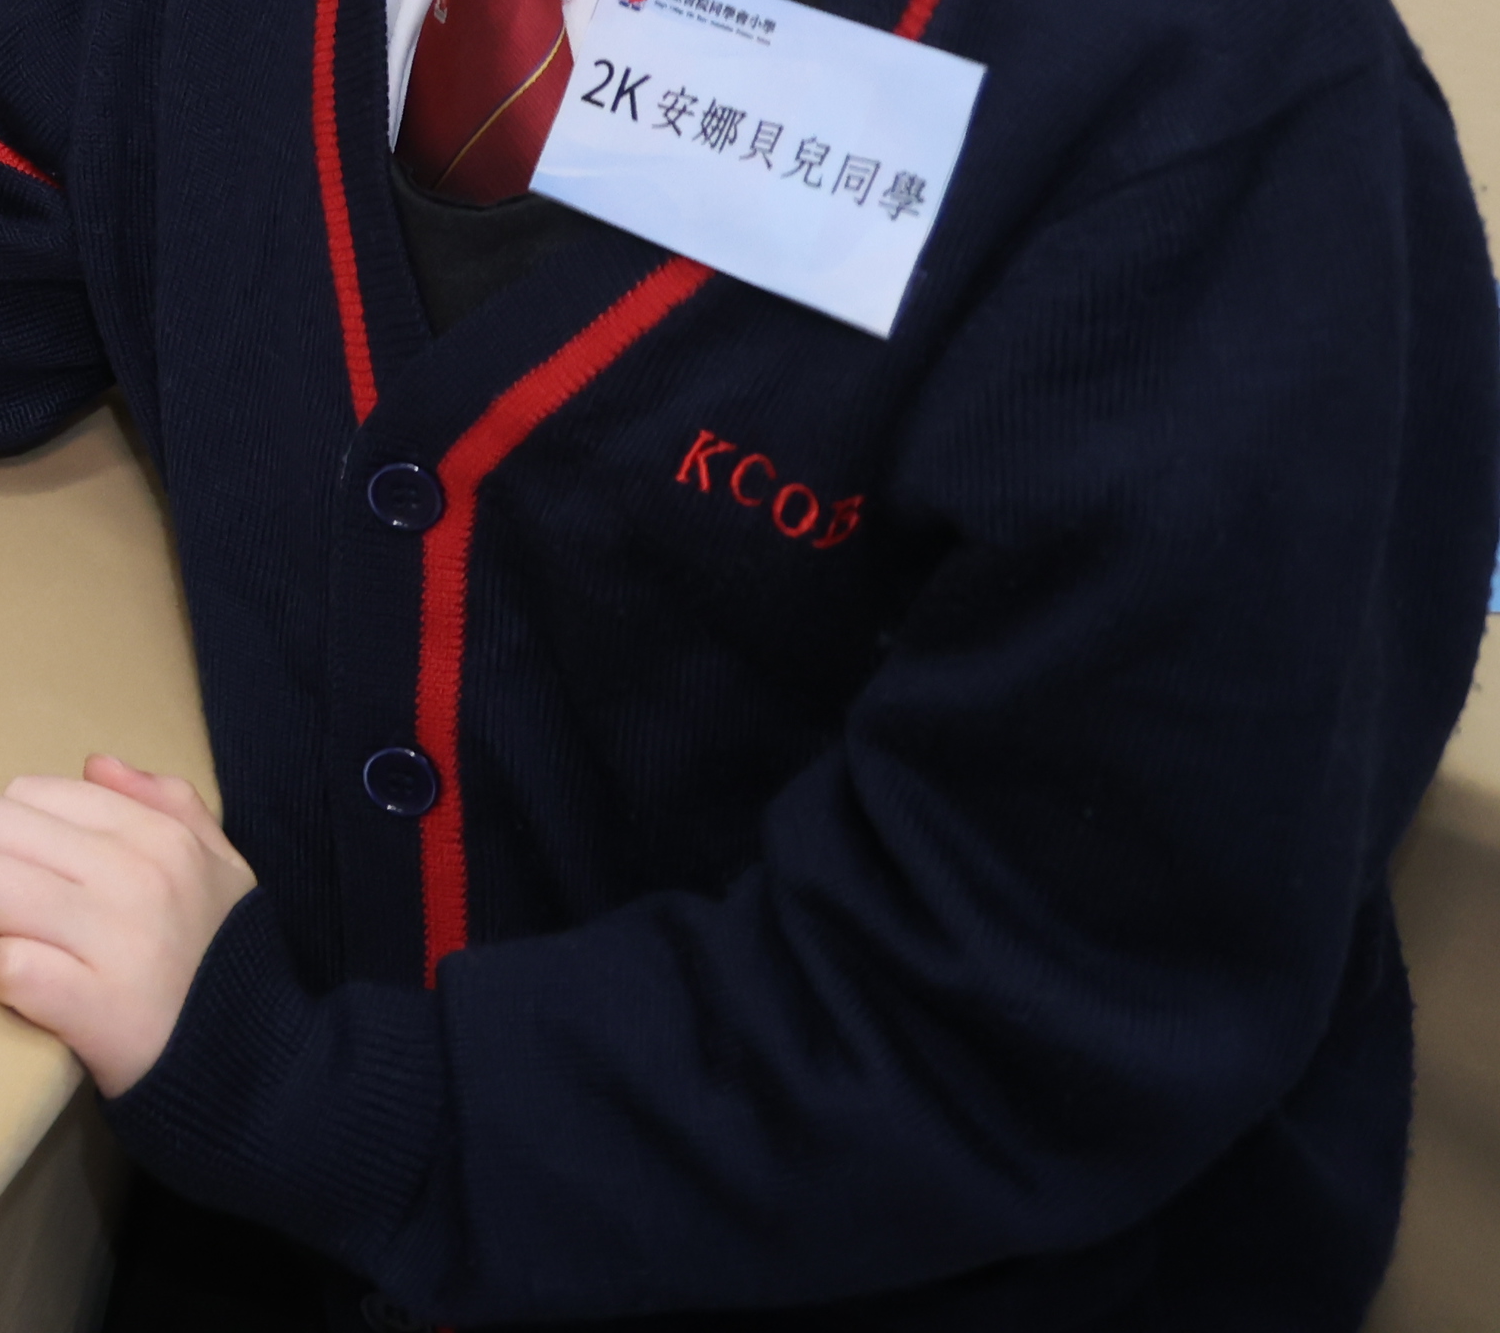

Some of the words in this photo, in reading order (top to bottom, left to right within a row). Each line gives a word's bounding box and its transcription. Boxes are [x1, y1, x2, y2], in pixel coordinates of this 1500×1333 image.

[580, 58, 652, 123] 2K
[652, 86, 929, 222] 安娜貝兒同學
